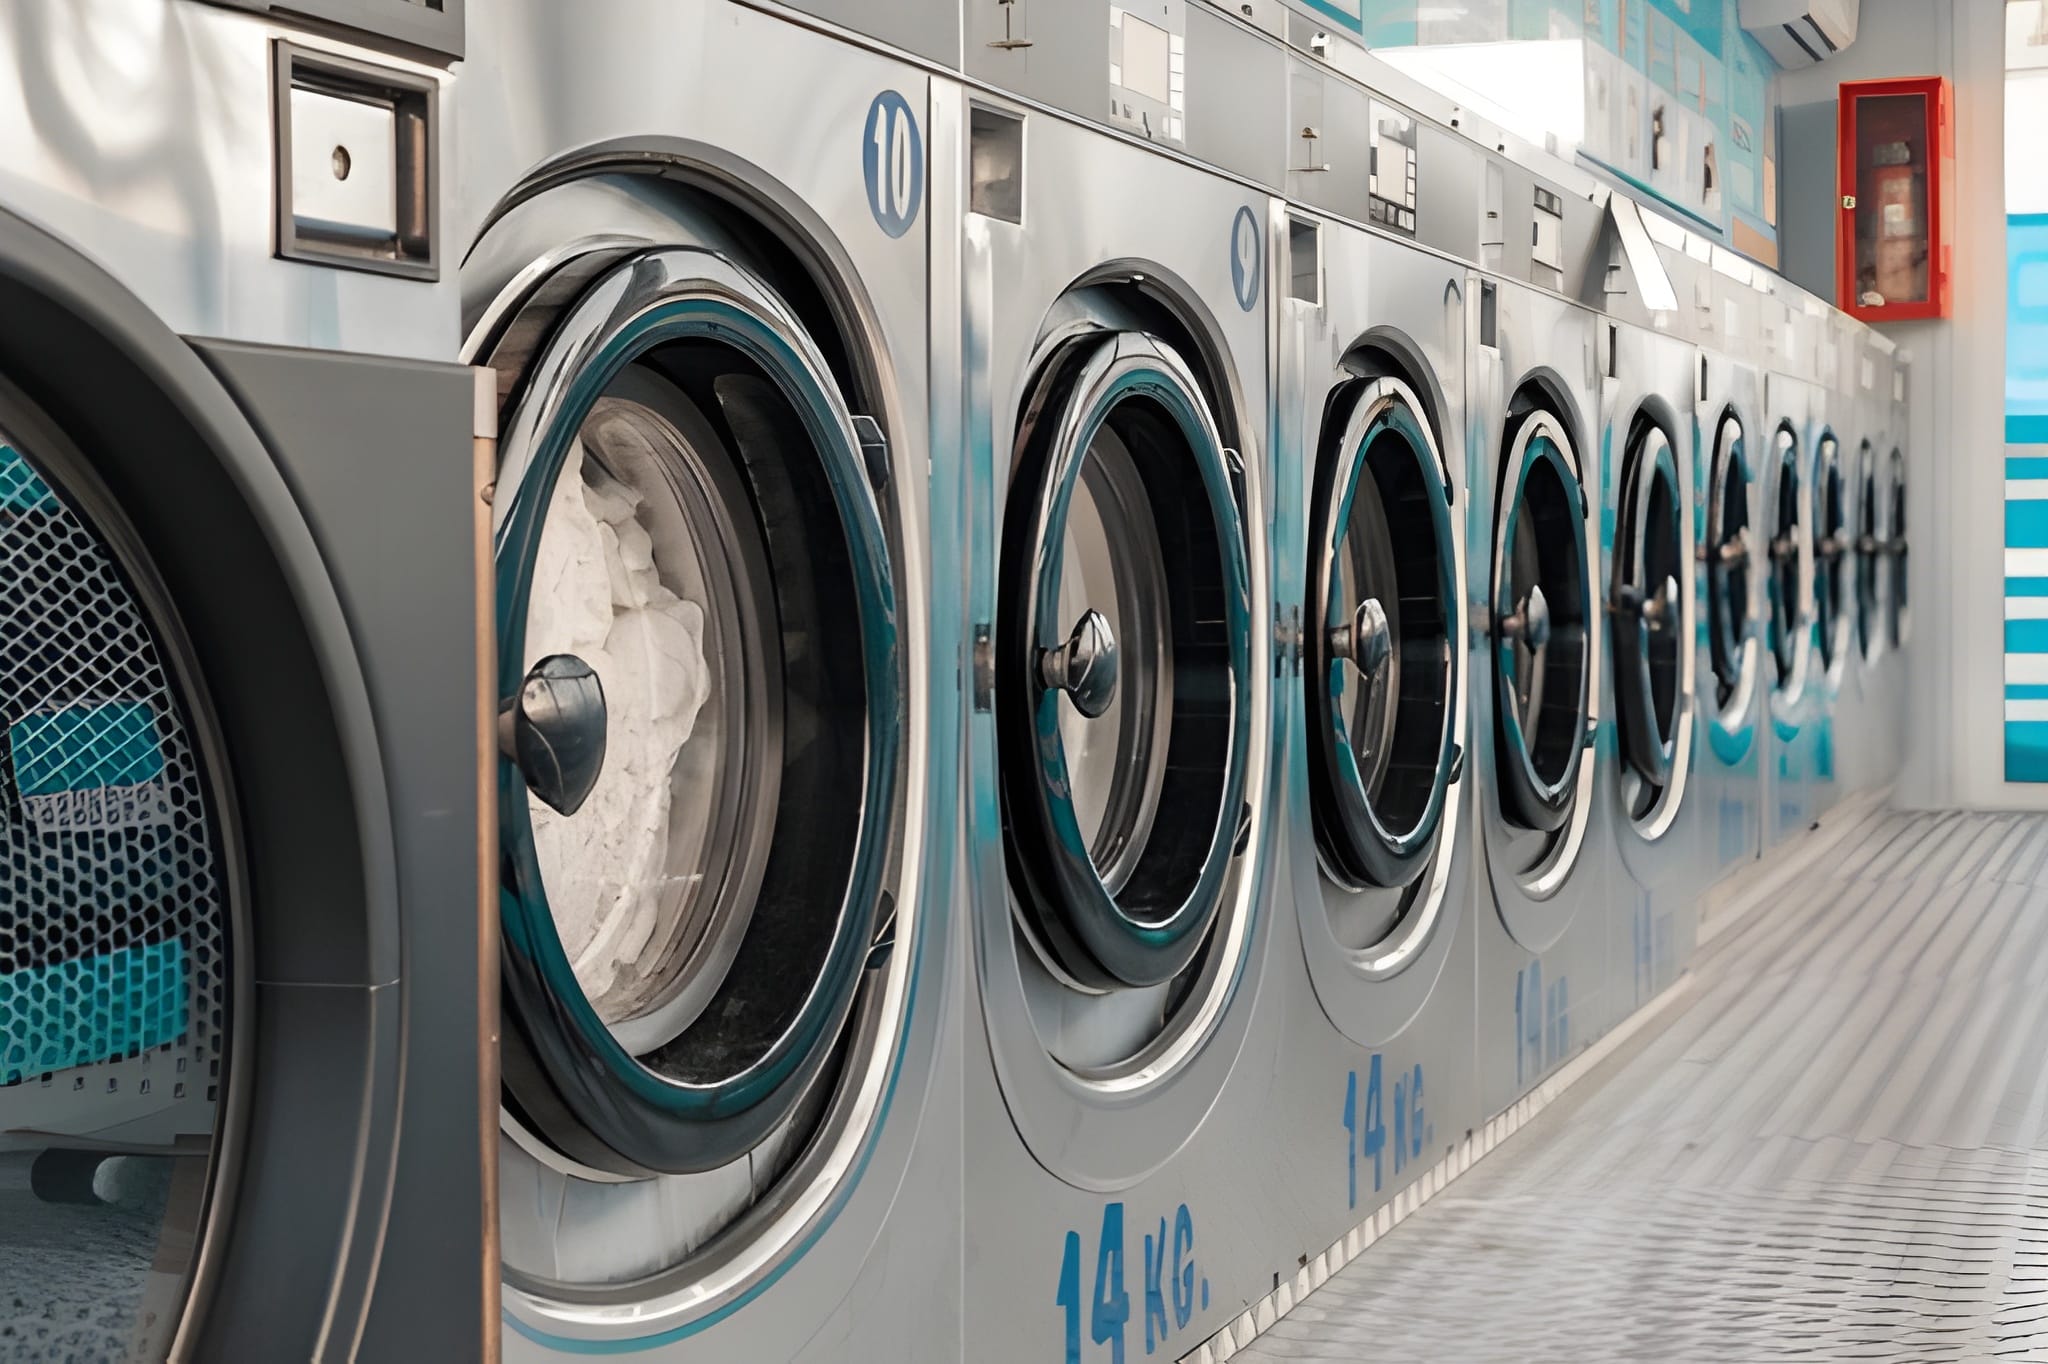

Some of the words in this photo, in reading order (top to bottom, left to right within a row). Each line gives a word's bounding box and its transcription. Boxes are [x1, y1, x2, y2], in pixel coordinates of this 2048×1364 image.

[872, 102, 913, 221] 10
[1343, 1053, 1386, 1210] 14
[1056, 1202, 1130, 1364] 14
[1144, 1203, 1210, 1355] KG.
